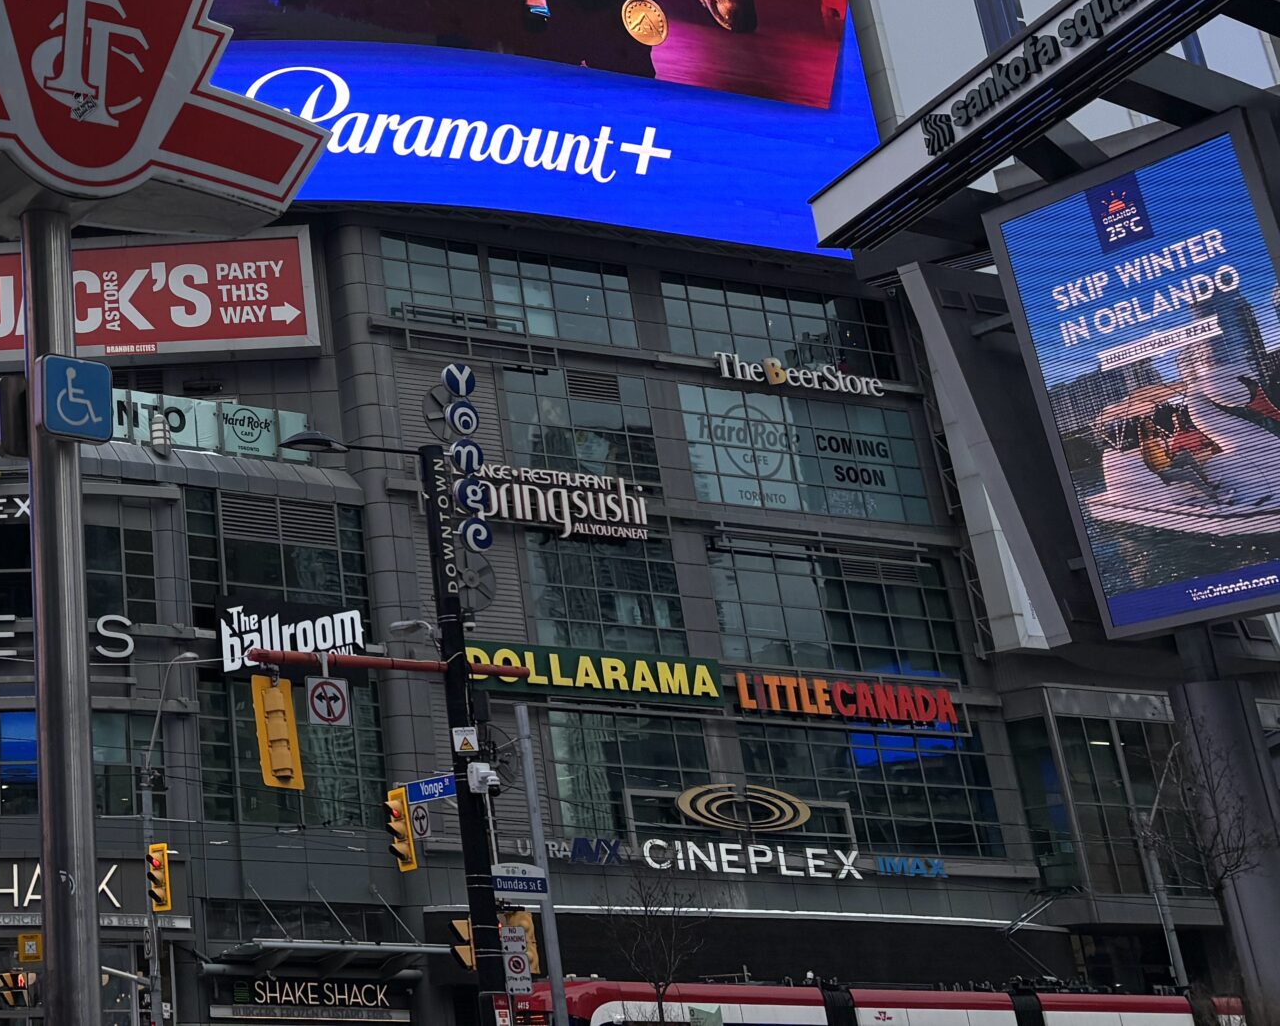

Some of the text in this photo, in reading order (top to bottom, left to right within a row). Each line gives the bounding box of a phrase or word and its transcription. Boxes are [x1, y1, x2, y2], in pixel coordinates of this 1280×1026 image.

[951, 34, 1062, 127] sankofa
[245, 66, 672, 183] Paramount+
[1102, 206, 1138, 226] ORLANDO
[1105, 217, 1144, 243] 25°C
[216, 260, 285, 282] PARTY
[1051, 228, 1227, 311] SKIP WINTER
[103, 270, 122, 332] ASTORS
[218, 282, 270, 303] THIS
[1059, 264, 1242, 348] IN ORLANDO
[220, 304, 269, 325] WAY
[714, 352, 885, 398] The Beer Store
[246, 415, 273, 433] Rock
[696, 414, 748, 445] Hard
[442, 363, 493, 552] Yonge
[742, 452, 770, 466] CAFE
[816, 434, 890, 460] COMING
[520, 467, 614, 490] RESTAURANT
[834, 464, 887, 487] SOON
[738, 489, 787, 505] TORONTO
[432, 458, 459, 594] DOWNTOWN
[226, 605, 259, 634] The
[220, 609, 365, 674] ballroom
[465, 646, 720, 698] DOLLARAMA
[832, 681, 959, 725] CANADA
[419, 781, 444, 800] Yonge
[642, 838, 863, 881] CINEPLEX
[877, 856, 948, 879] IMAX
[496, 878, 528, 891] Dundas
[537, 880, 543, 891] E
[254, 980, 390, 1008] SHAKE SHACK
